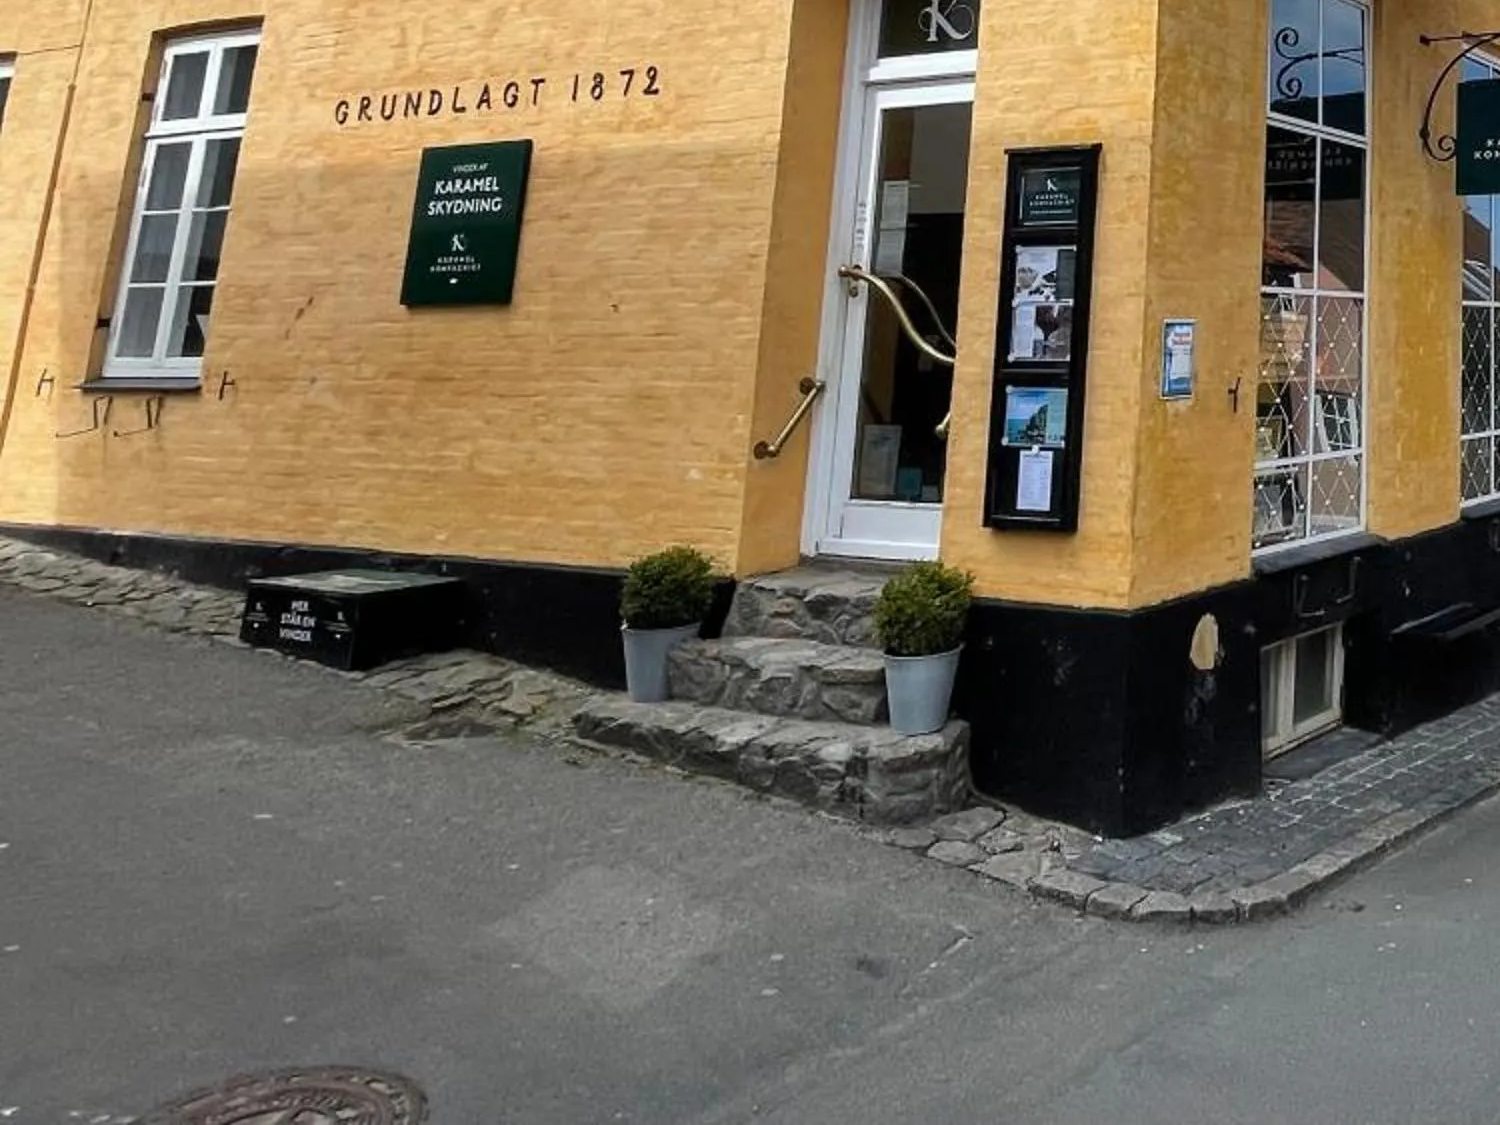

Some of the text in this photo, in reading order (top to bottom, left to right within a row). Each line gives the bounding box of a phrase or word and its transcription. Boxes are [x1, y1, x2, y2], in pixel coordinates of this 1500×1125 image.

[334, 66, 661, 125] GRUNDLAGT 1872
[435, 176, 500, 195] KARAMEL
[428, 196, 503, 216] SKYDNING
